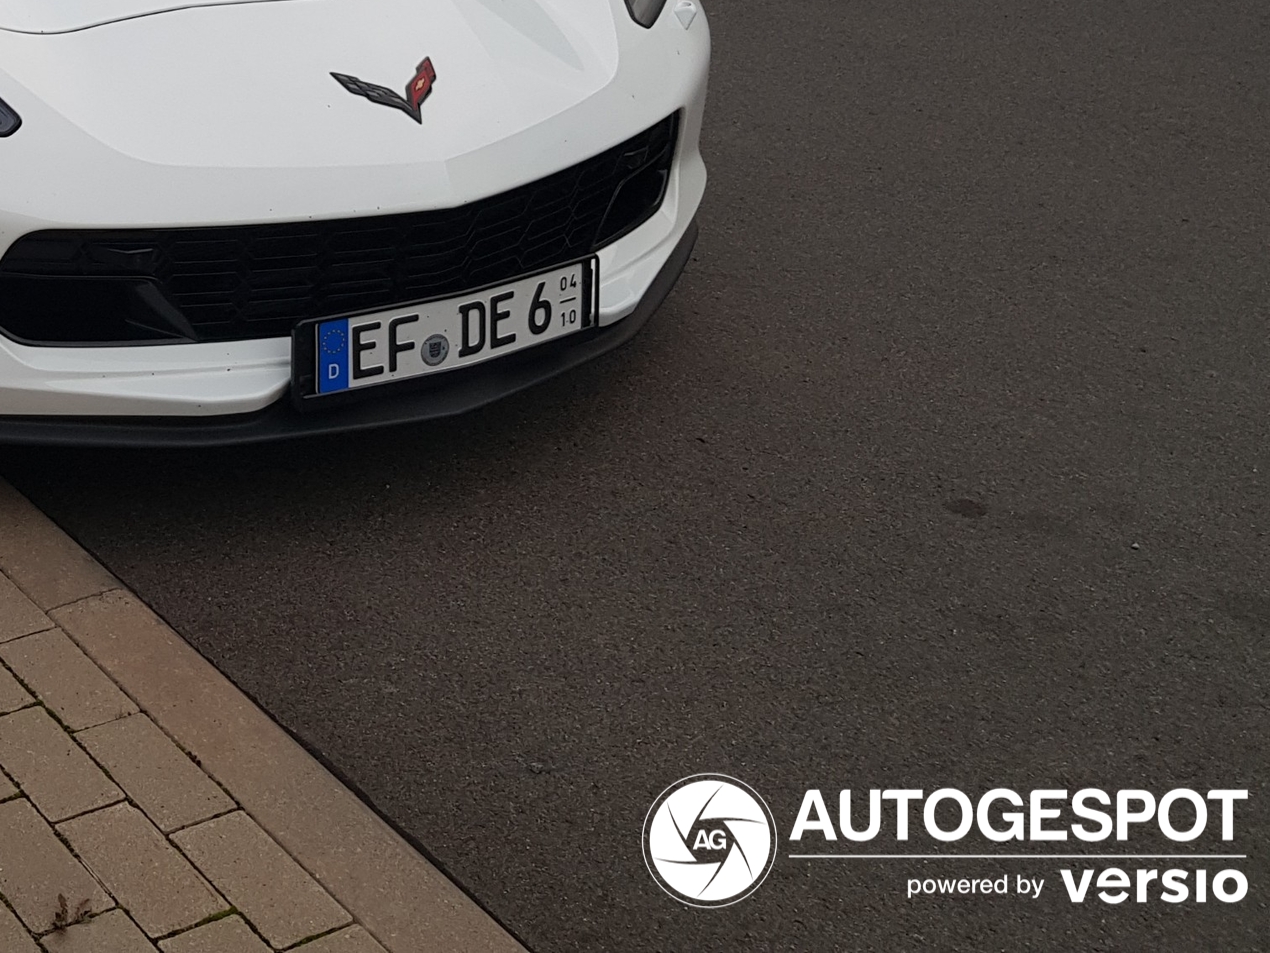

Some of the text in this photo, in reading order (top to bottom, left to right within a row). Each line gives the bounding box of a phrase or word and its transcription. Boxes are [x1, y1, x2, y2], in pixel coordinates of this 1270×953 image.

[560, 273, 577, 291] 04
[561, 309, 577, 327] 10
[352, 281, 552, 380] EF DE 6
[328, 363, 339, 380] D
